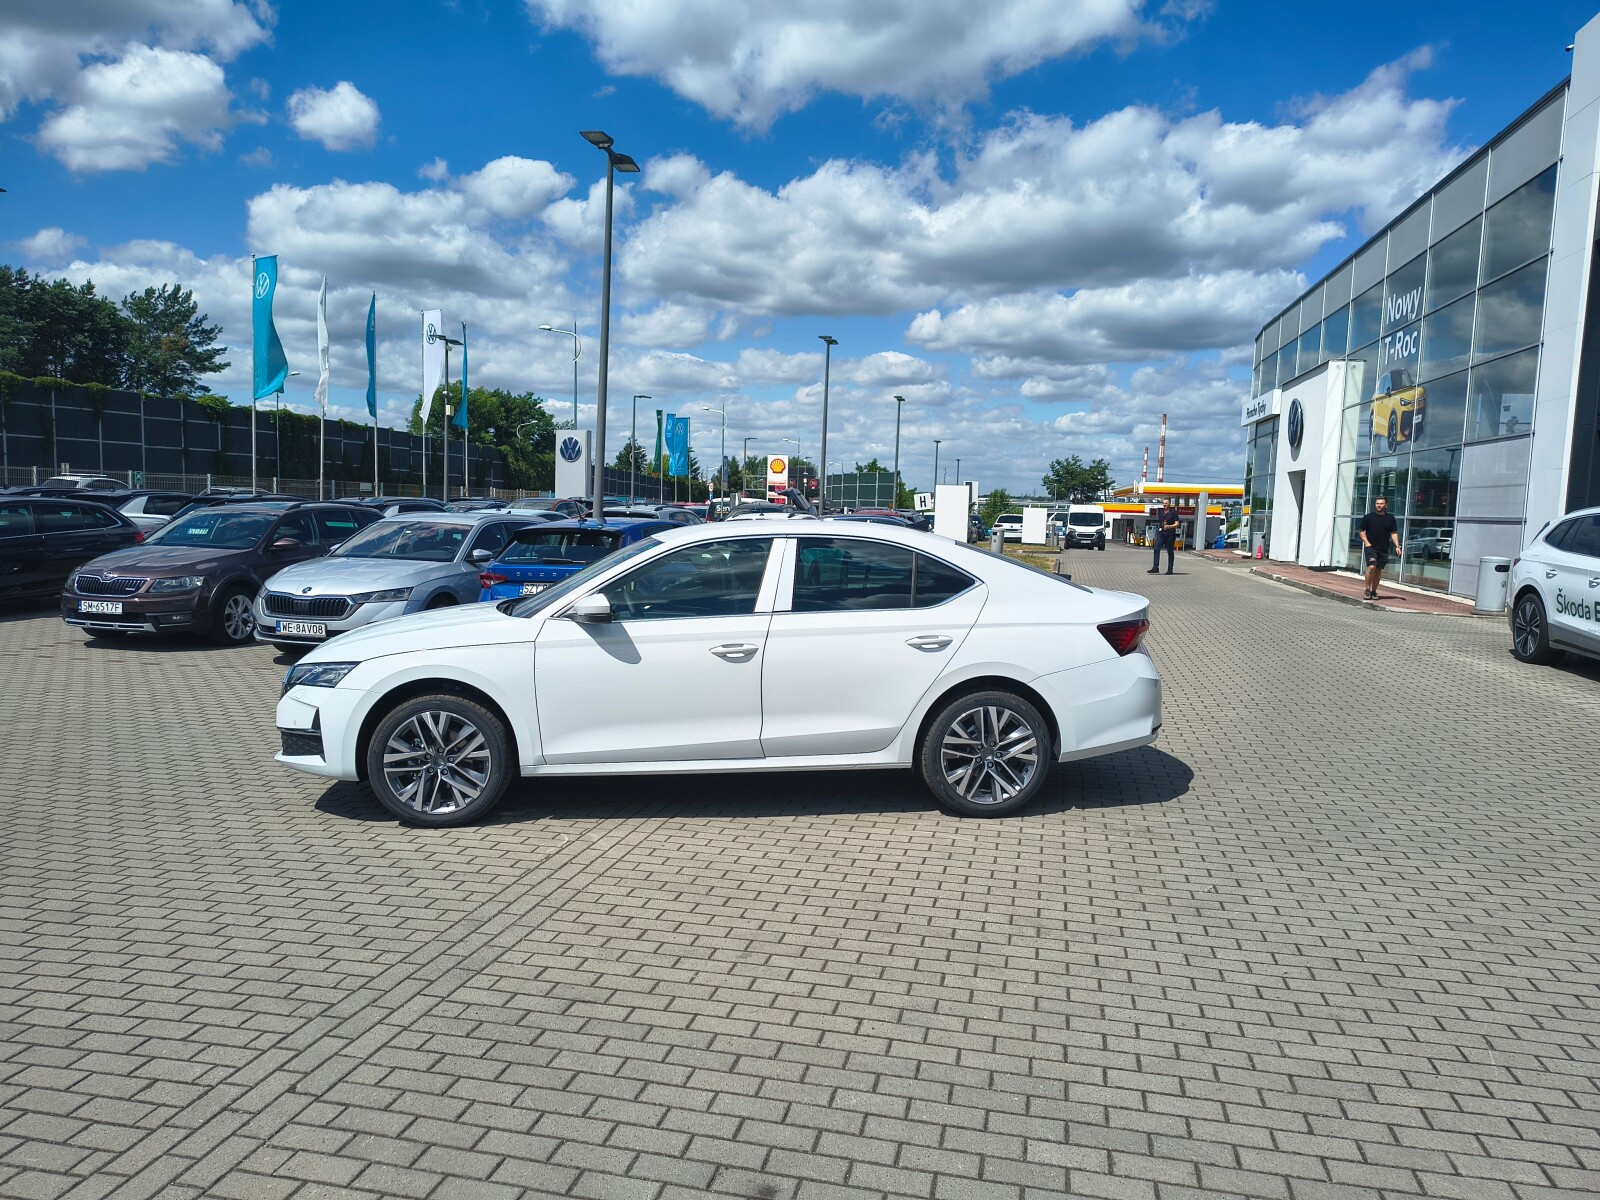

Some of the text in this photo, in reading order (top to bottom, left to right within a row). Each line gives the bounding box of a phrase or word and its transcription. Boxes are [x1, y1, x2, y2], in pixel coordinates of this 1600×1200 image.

[1386, 286, 1422, 324] Nowy
[1384, 330, 1418, 365] T-Roc
[919, 495, 927, 508] H
[95, 602, 121, 612] 6517F
[1556, 587, 1592, 621] Škoda
